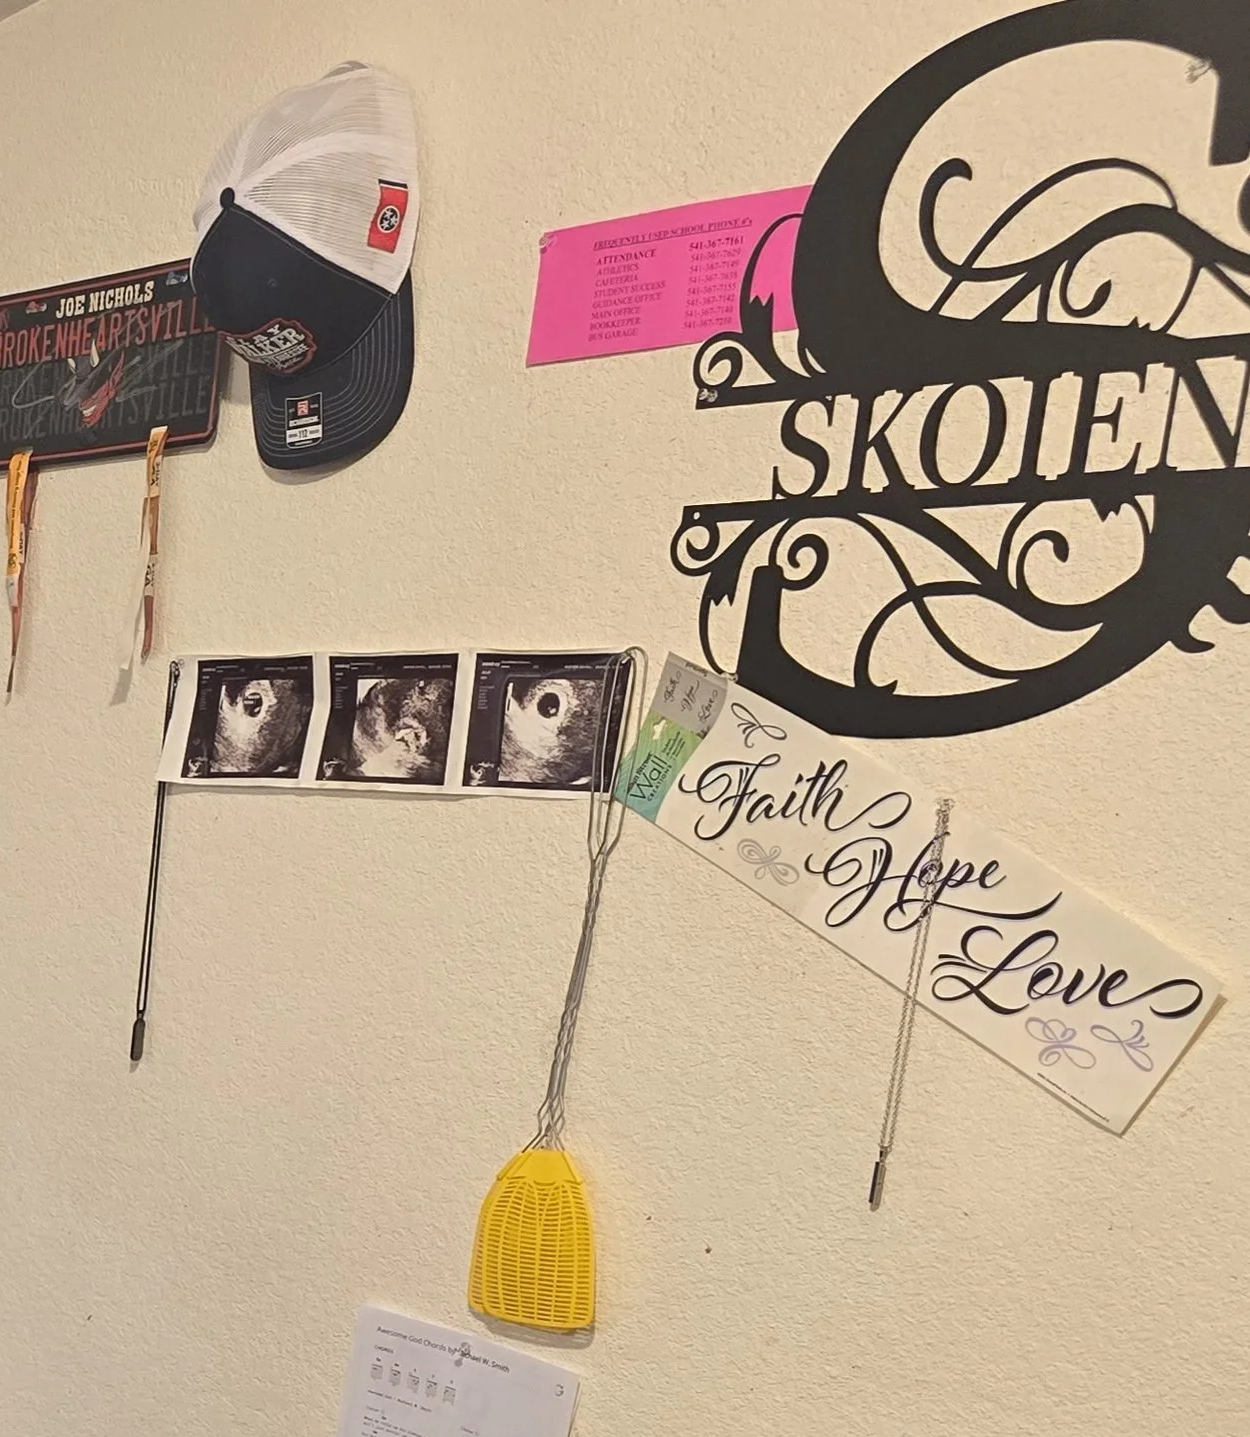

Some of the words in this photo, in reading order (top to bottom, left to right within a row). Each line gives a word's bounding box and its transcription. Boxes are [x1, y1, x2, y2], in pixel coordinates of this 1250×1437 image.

[596, 249, 657, 265] ATTENDANCE
[689, 236, 744, 251] 541-367-7161
[595, 274, 638, 287] CAFETERIA
[597, 262, 639, 276] ATHLETICS
[56, 297, 85, 319] JOE
[89, 281, 155, 313] NICHOLS
[590, 317, 642, 332] BOOKKEEPER
[604, 328, 638, 340] GARAGE
[772, 355, 1250, 501] SKOIEN
[630, 755, 668, 801] Wall
[679, 753, 911, 840] Faith
[805, 831, 1062, 931] Hope
[930, 925, 1203, 1018] Love
[377, 1326, 408, 1340] Awesome
[408, 1335, 423, 1345] God
[423, 1339, 447, 1352] Chords
[491, 1361, 510, 1374] Smith
